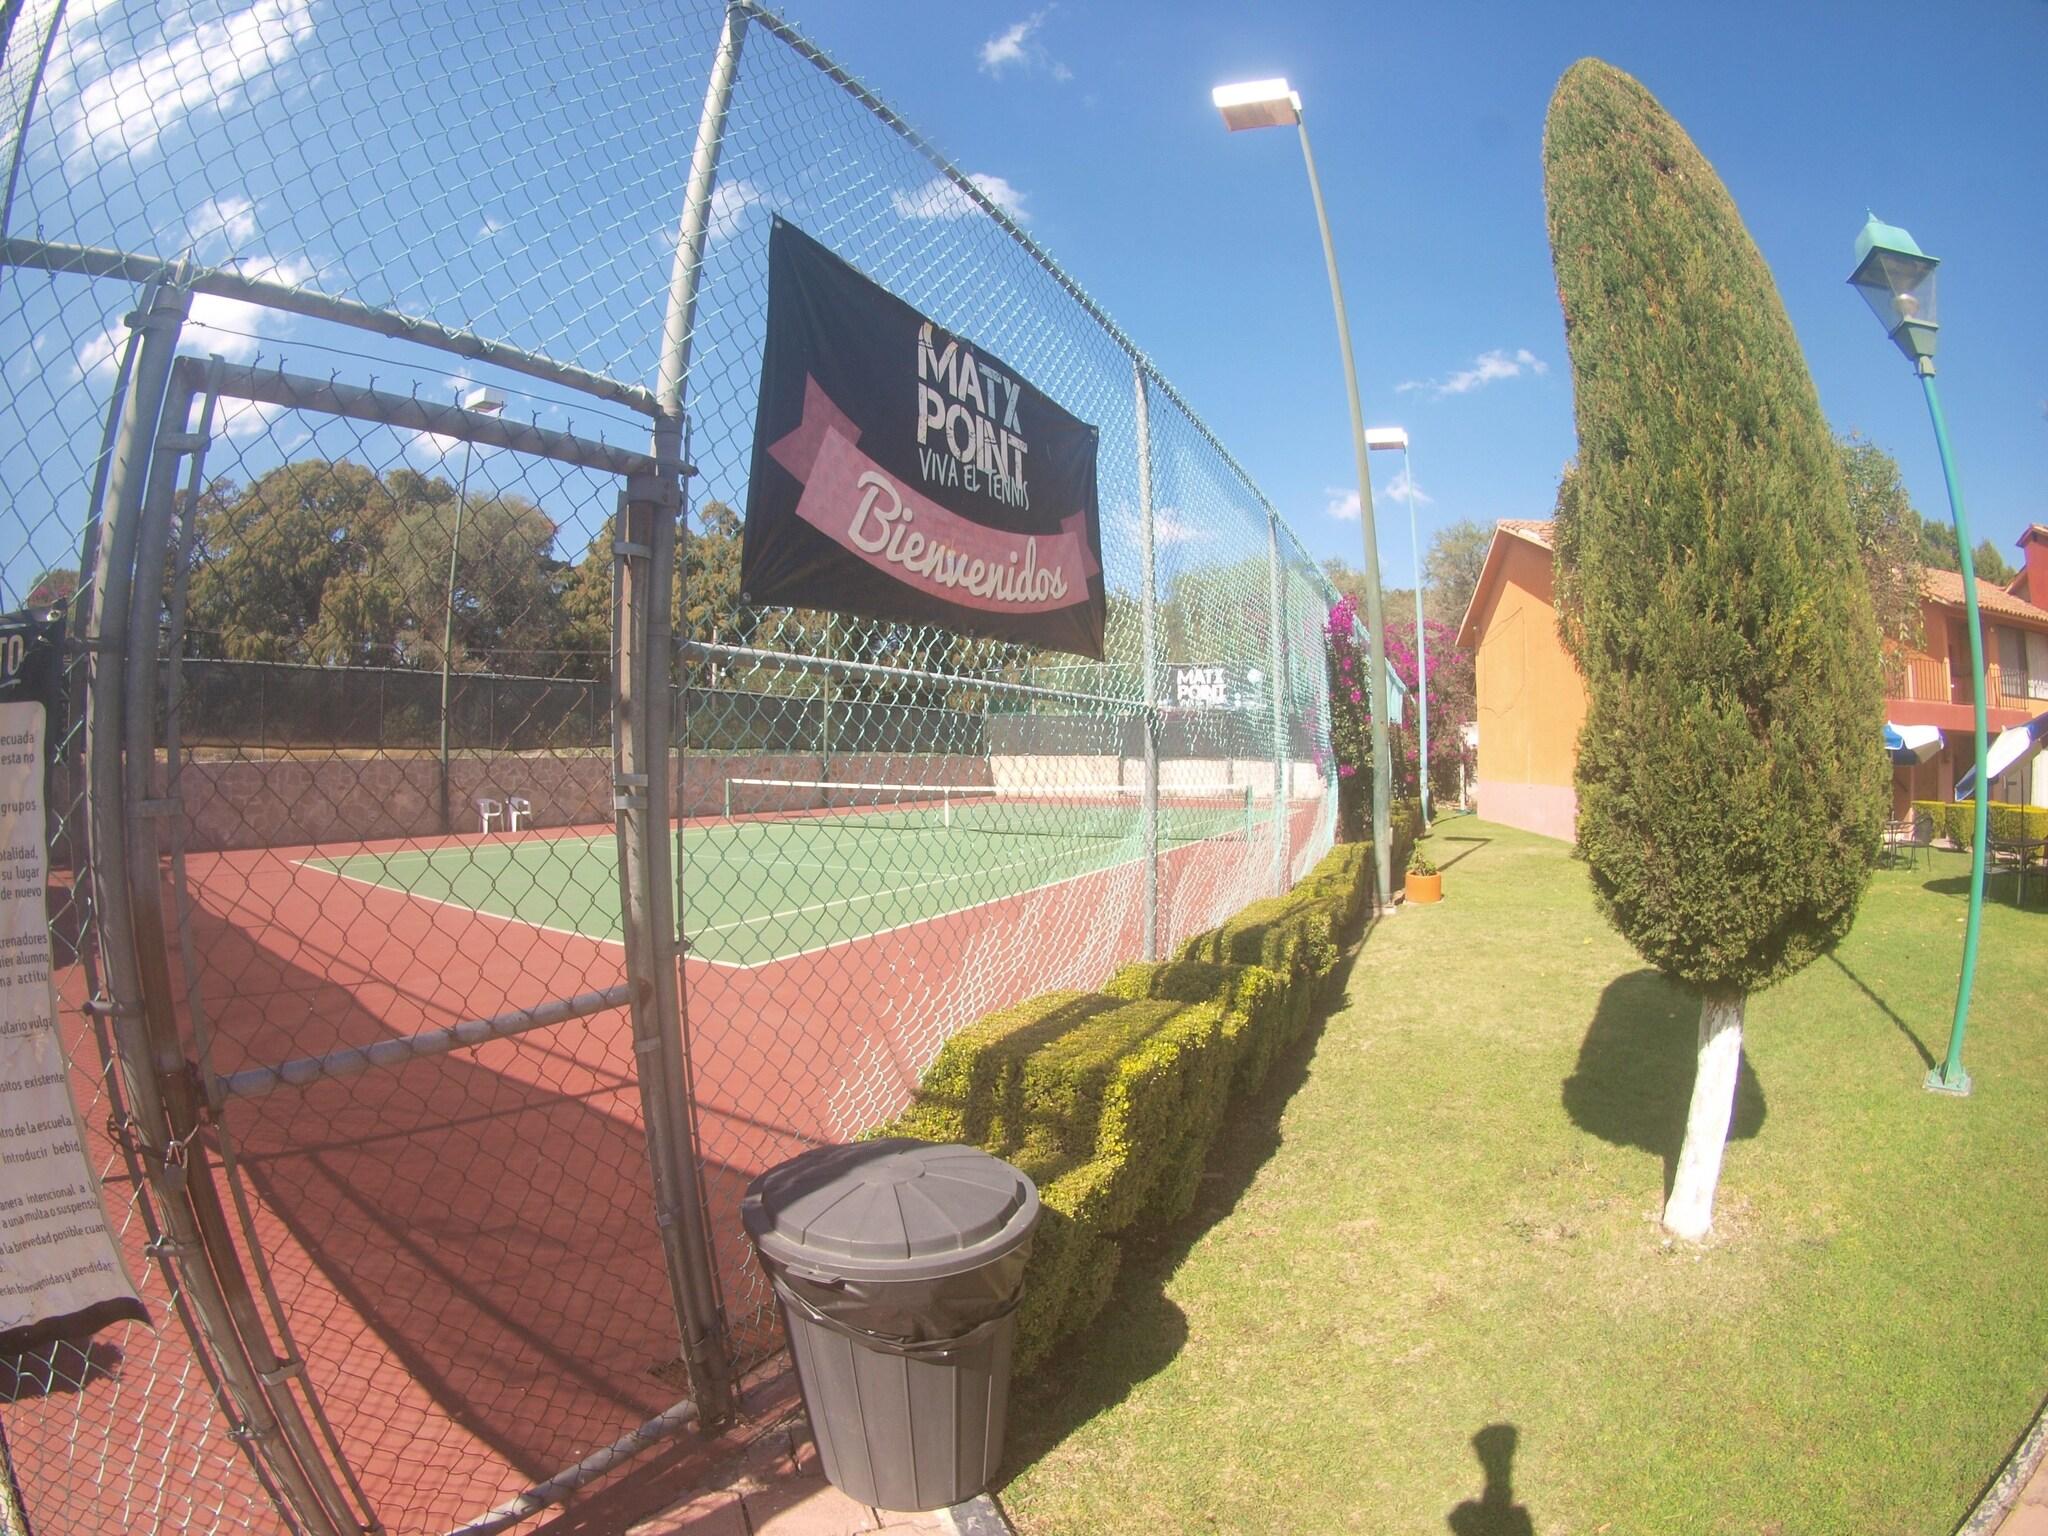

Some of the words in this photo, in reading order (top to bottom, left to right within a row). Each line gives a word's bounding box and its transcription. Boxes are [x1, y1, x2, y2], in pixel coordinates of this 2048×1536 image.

[916, 382, 1028, 492] POINT
[919, 448, 959, 487] VIVA
[963, 463, 982, 492] EL
[987, 468, 1030, 511] TENNIS
[848, 471, 1068, 602] Bienvenidos
[1177, 684, 1228, 704] POINT
[1, 753, 21, 765] esta
[23, 752, 35, 764] no
[1, 800, 37, 817] grupos
[2, 871, 12, 881] su
[16, 865, 40, 883] lugar
[1, 887, 12, 900] de
[15, 887, 42, 899] nuevo
[15, 1123, 26, 1136] de
[26, 1121, 37, 1134] la
[2, 1146, 48, 1164] introducir
[52, 1141, 83, 1155] bebid
[26, 1183, 76, 1204] intencional
[79, 1184, 86, 1193] a
[2, 1219, 8, 1228] a
[8, 1215, 24, 1227] una
[24, 1207, 50, 1222] multa
[50, 1207, 56, 1217] o
[3, 1242, 14, 1254] la
[12, 1232, 52, 1253] brevedad
[52, 1225, 84, 1246] posible
[16, 1273, 66, 1295] bienvenidas
[64, 1272, 72, 1284] y
